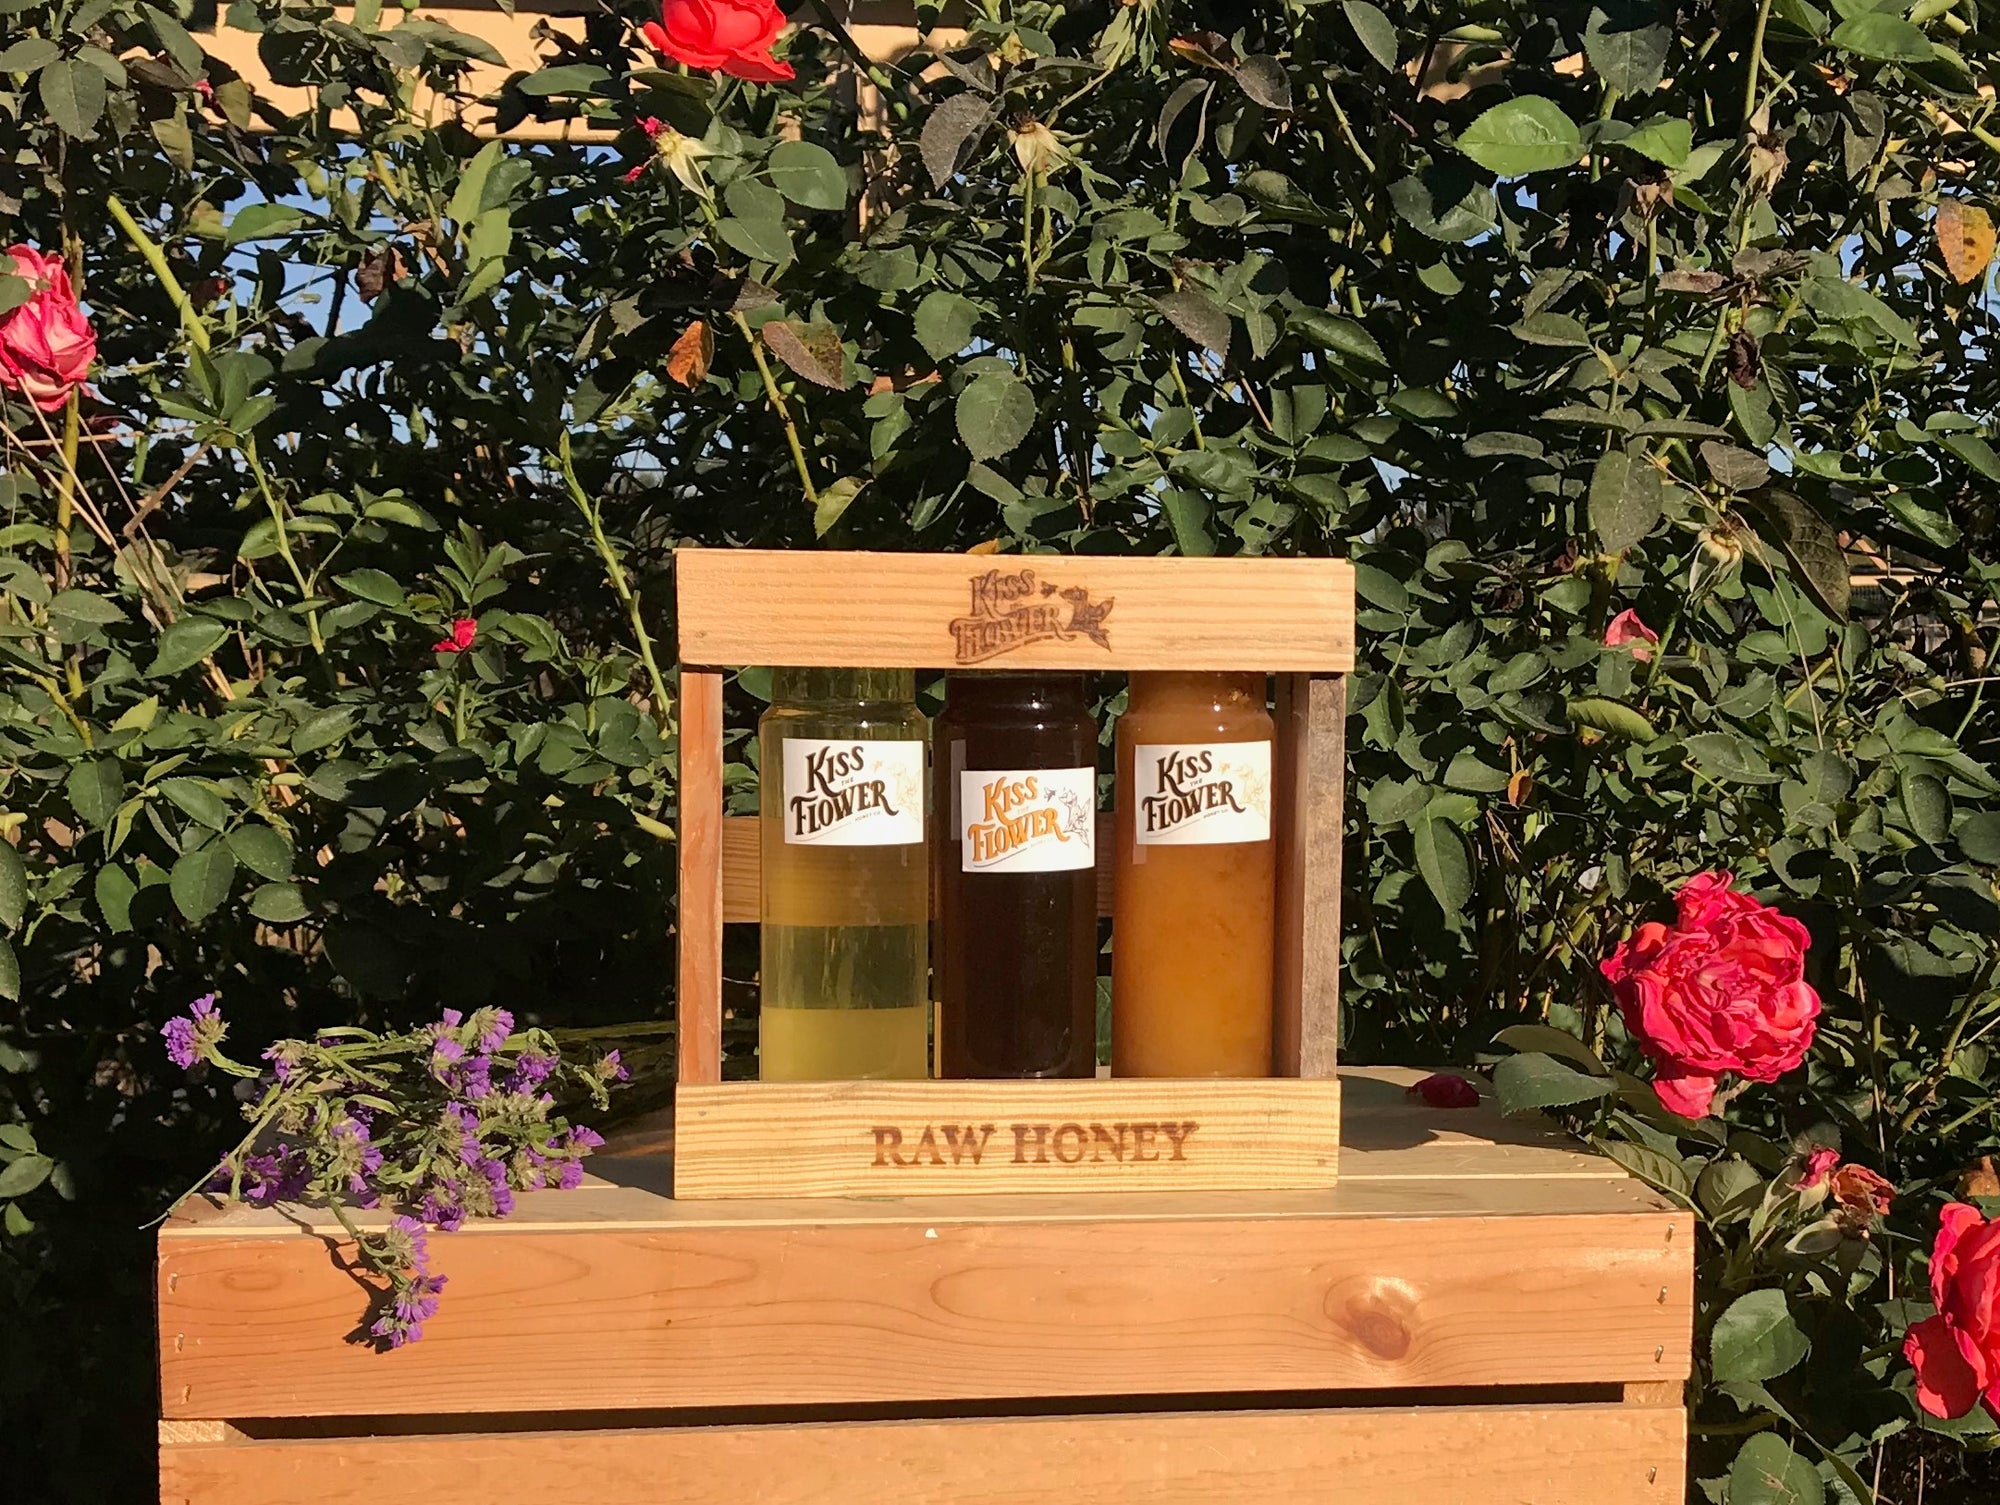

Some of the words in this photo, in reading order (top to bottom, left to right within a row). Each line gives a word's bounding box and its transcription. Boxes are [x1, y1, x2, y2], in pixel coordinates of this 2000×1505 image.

[969, 568, 1035, 620] KISS
[805, 745, 864, 798] KISS
[1156, 750, 1212, 797] KISS
[790, 779, 900, 836] FLOWER
[983, 776, 1038, 826] KISS
[1141, 780, 1246, 832] FLOWER
[967, 807, 1071, 862] FLOWER
[871, 1124, 998, 1167] RAW
[1010, 1120, 1200, 1164] HONEY
